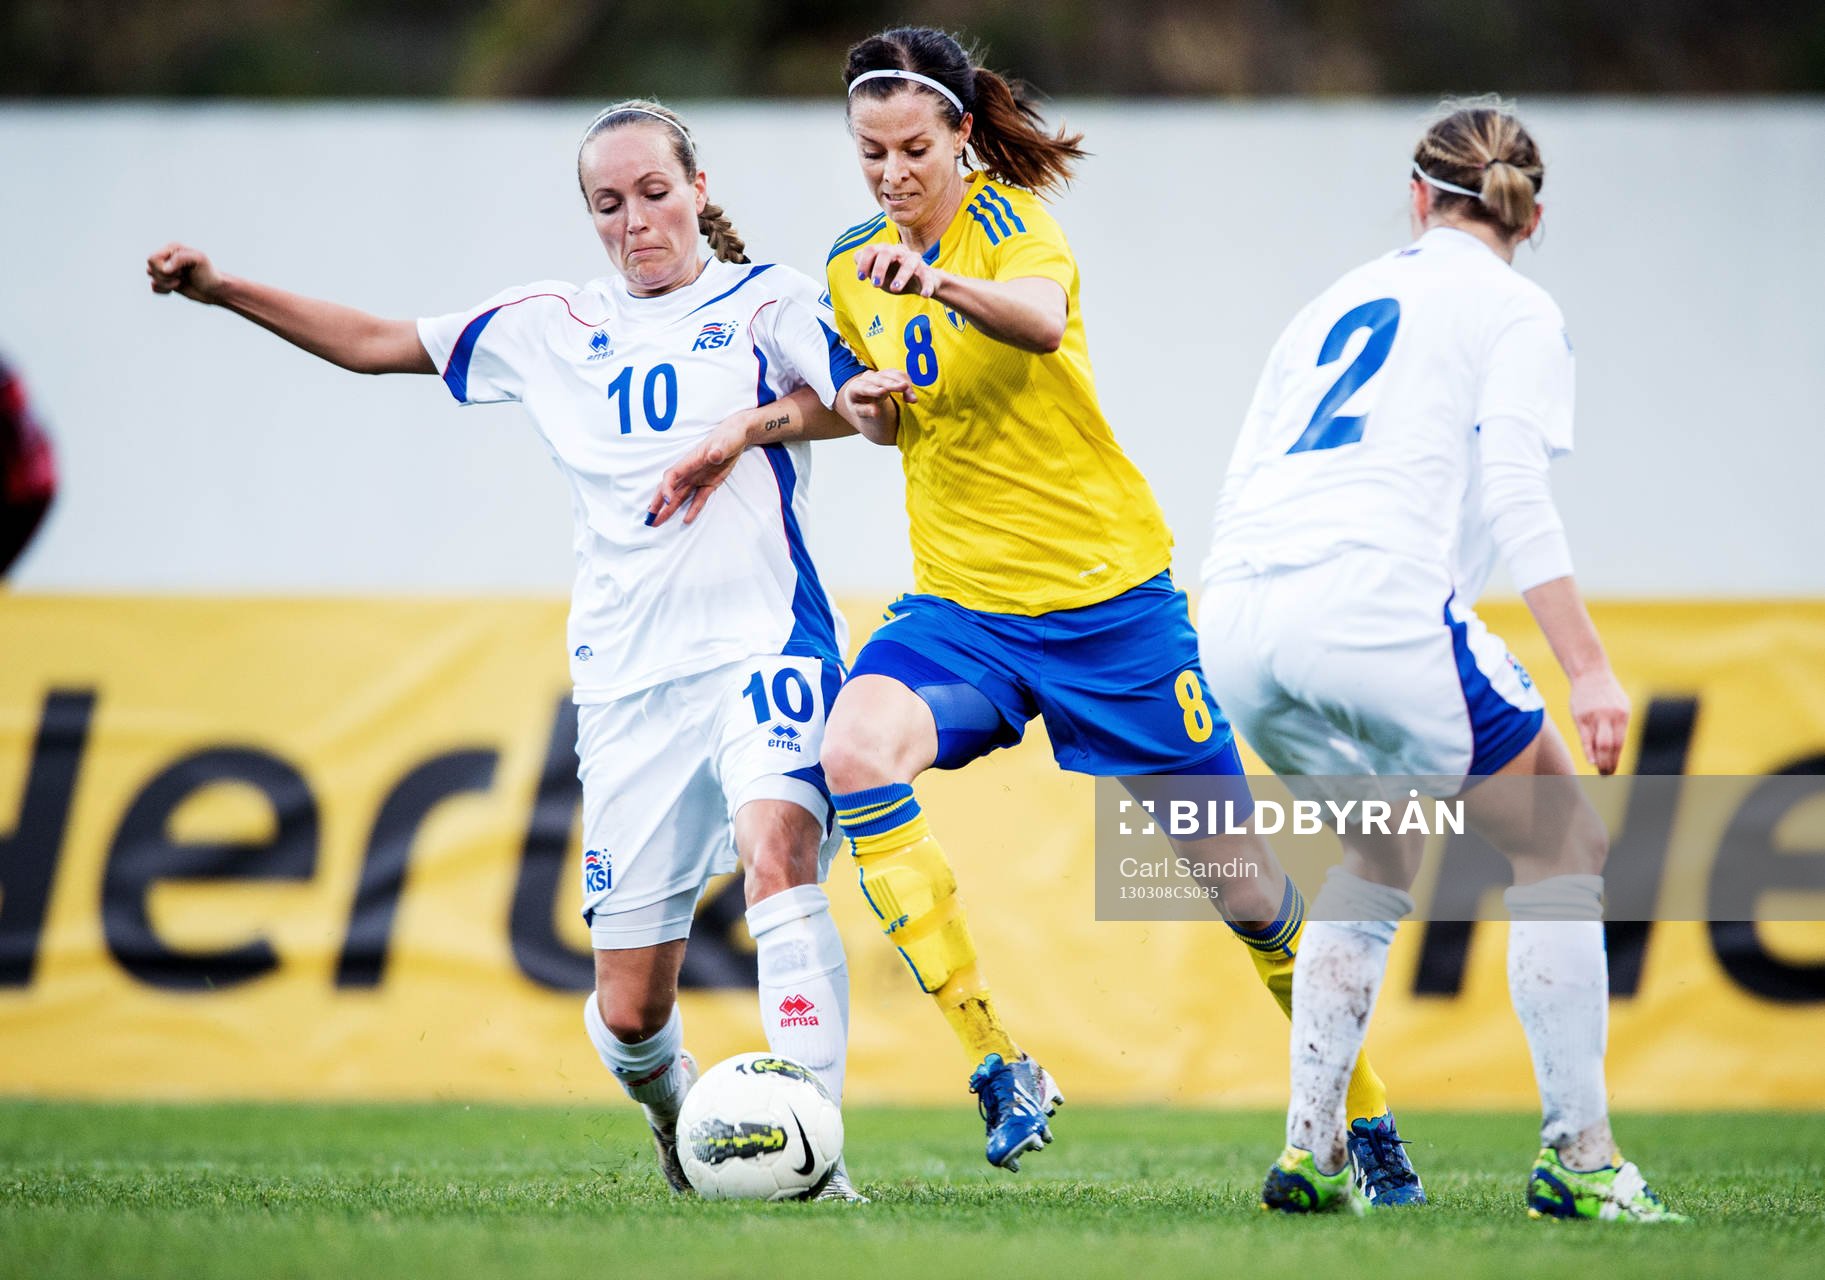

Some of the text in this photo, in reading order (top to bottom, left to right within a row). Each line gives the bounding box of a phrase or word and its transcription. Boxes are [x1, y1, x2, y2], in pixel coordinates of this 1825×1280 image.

[904, 314, 939, 387] 8
[1285, 297, 1401, 456] 2
[608, 363, 678, 435] 10
[742, 667, 814, 725] 10
[1174, 670, 1213, 743] 8
